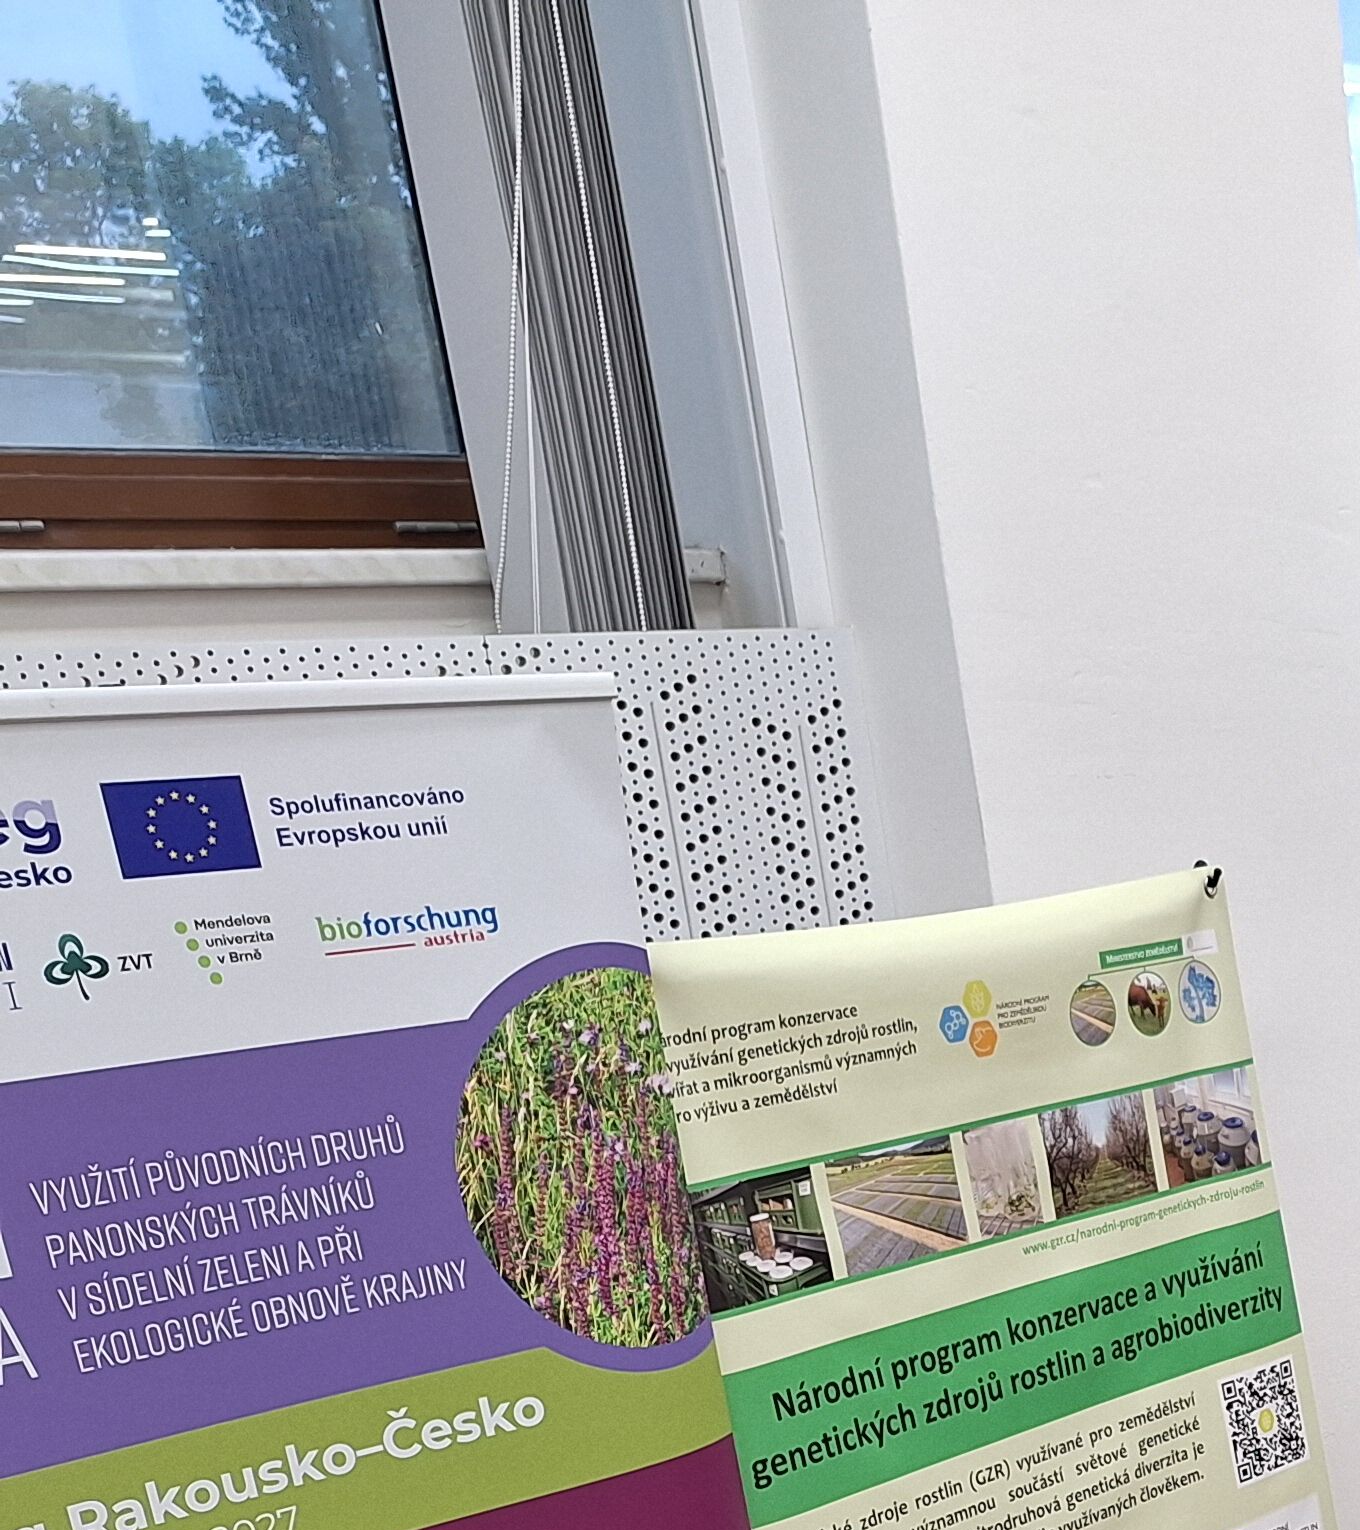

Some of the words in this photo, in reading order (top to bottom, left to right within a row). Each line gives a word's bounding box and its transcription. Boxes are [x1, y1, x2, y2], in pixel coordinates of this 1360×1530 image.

[269, 786, 465, 820] Spolufinancováno
[275, 821, 401, 849] Evropskou
[406, 814, 448, 837] unií
[193, 913, 271, 931] Mendelova
[205, 930, 275, 948] univerzita
[314, 905, 499, 942] bioforschung
[423, 928, 486, 947] austria
[116, 952, 153, 973] ZVT
[216, 955, 226, 965] v
[228, 948, 263, 964] Brně
[710, 1019, 776, 1045] program
[778, 1006, 858, 1030] konzervace
[663, 1046, 734, 1077] využívání
[737, 1032, 823, 1067] genetických
[825, 1023, 869, 1046] zdrojů
[871, 1017, 918, 1038] rostlin,
[28, 1157, 141, 1215] VYUŽITÍ
[144, 1135, 307, 1196] PŮVODNÍCH
[310, 1114, 405, 1167] DRUHŮ
[44, 1201, 240, 1269] PANONSKÝCH
[241, 1170, 375, 1230] TRÁVNÍKŮ
[57, 1285, 77, 1320] V
[84, 1254, 195, 1315] SÍDELNÍ
[196, 1244, 290, 1293] ZELENI
[297, 1240, 316, 1273] A
[316, 1224, 363, 1268] PŘI
[72, 1297, 249, 1373] EKOLOGICKÉ
[251, 1274, 361, 1332] OBNOVĚ
[362, 1258, 466, 1309] KRAJINY
[771, 1356, 885, 1422] Národní
[890, 1330, 1002, 1390] program
[1005, 1287, 1139, 1346] konzervace
[1144, 1281, 1157, 1302] a
[1161, 1240, 1264, 1298] využívání
[751, 1402, 917, 1490] genetických
[922, 1371, 1004, 1425] zdrojů
[1009, 1349, 1087, 1395] rostlin
[1092, 1345, 1106, 1367] a
[1110, 1285, 1282, 1362] agrobiodiverzity
[859, 1500, 909, 1530] zdroje
[914, 1480, 964, 1510] rostlin
[969, 1459, 1011, 1493] (GZR)
[1015, 1431, 1084, 1473] využívané
[1088, 1425, 1113, 1449] pro
[1118, 1390, 1196, 1433] zemědělství
